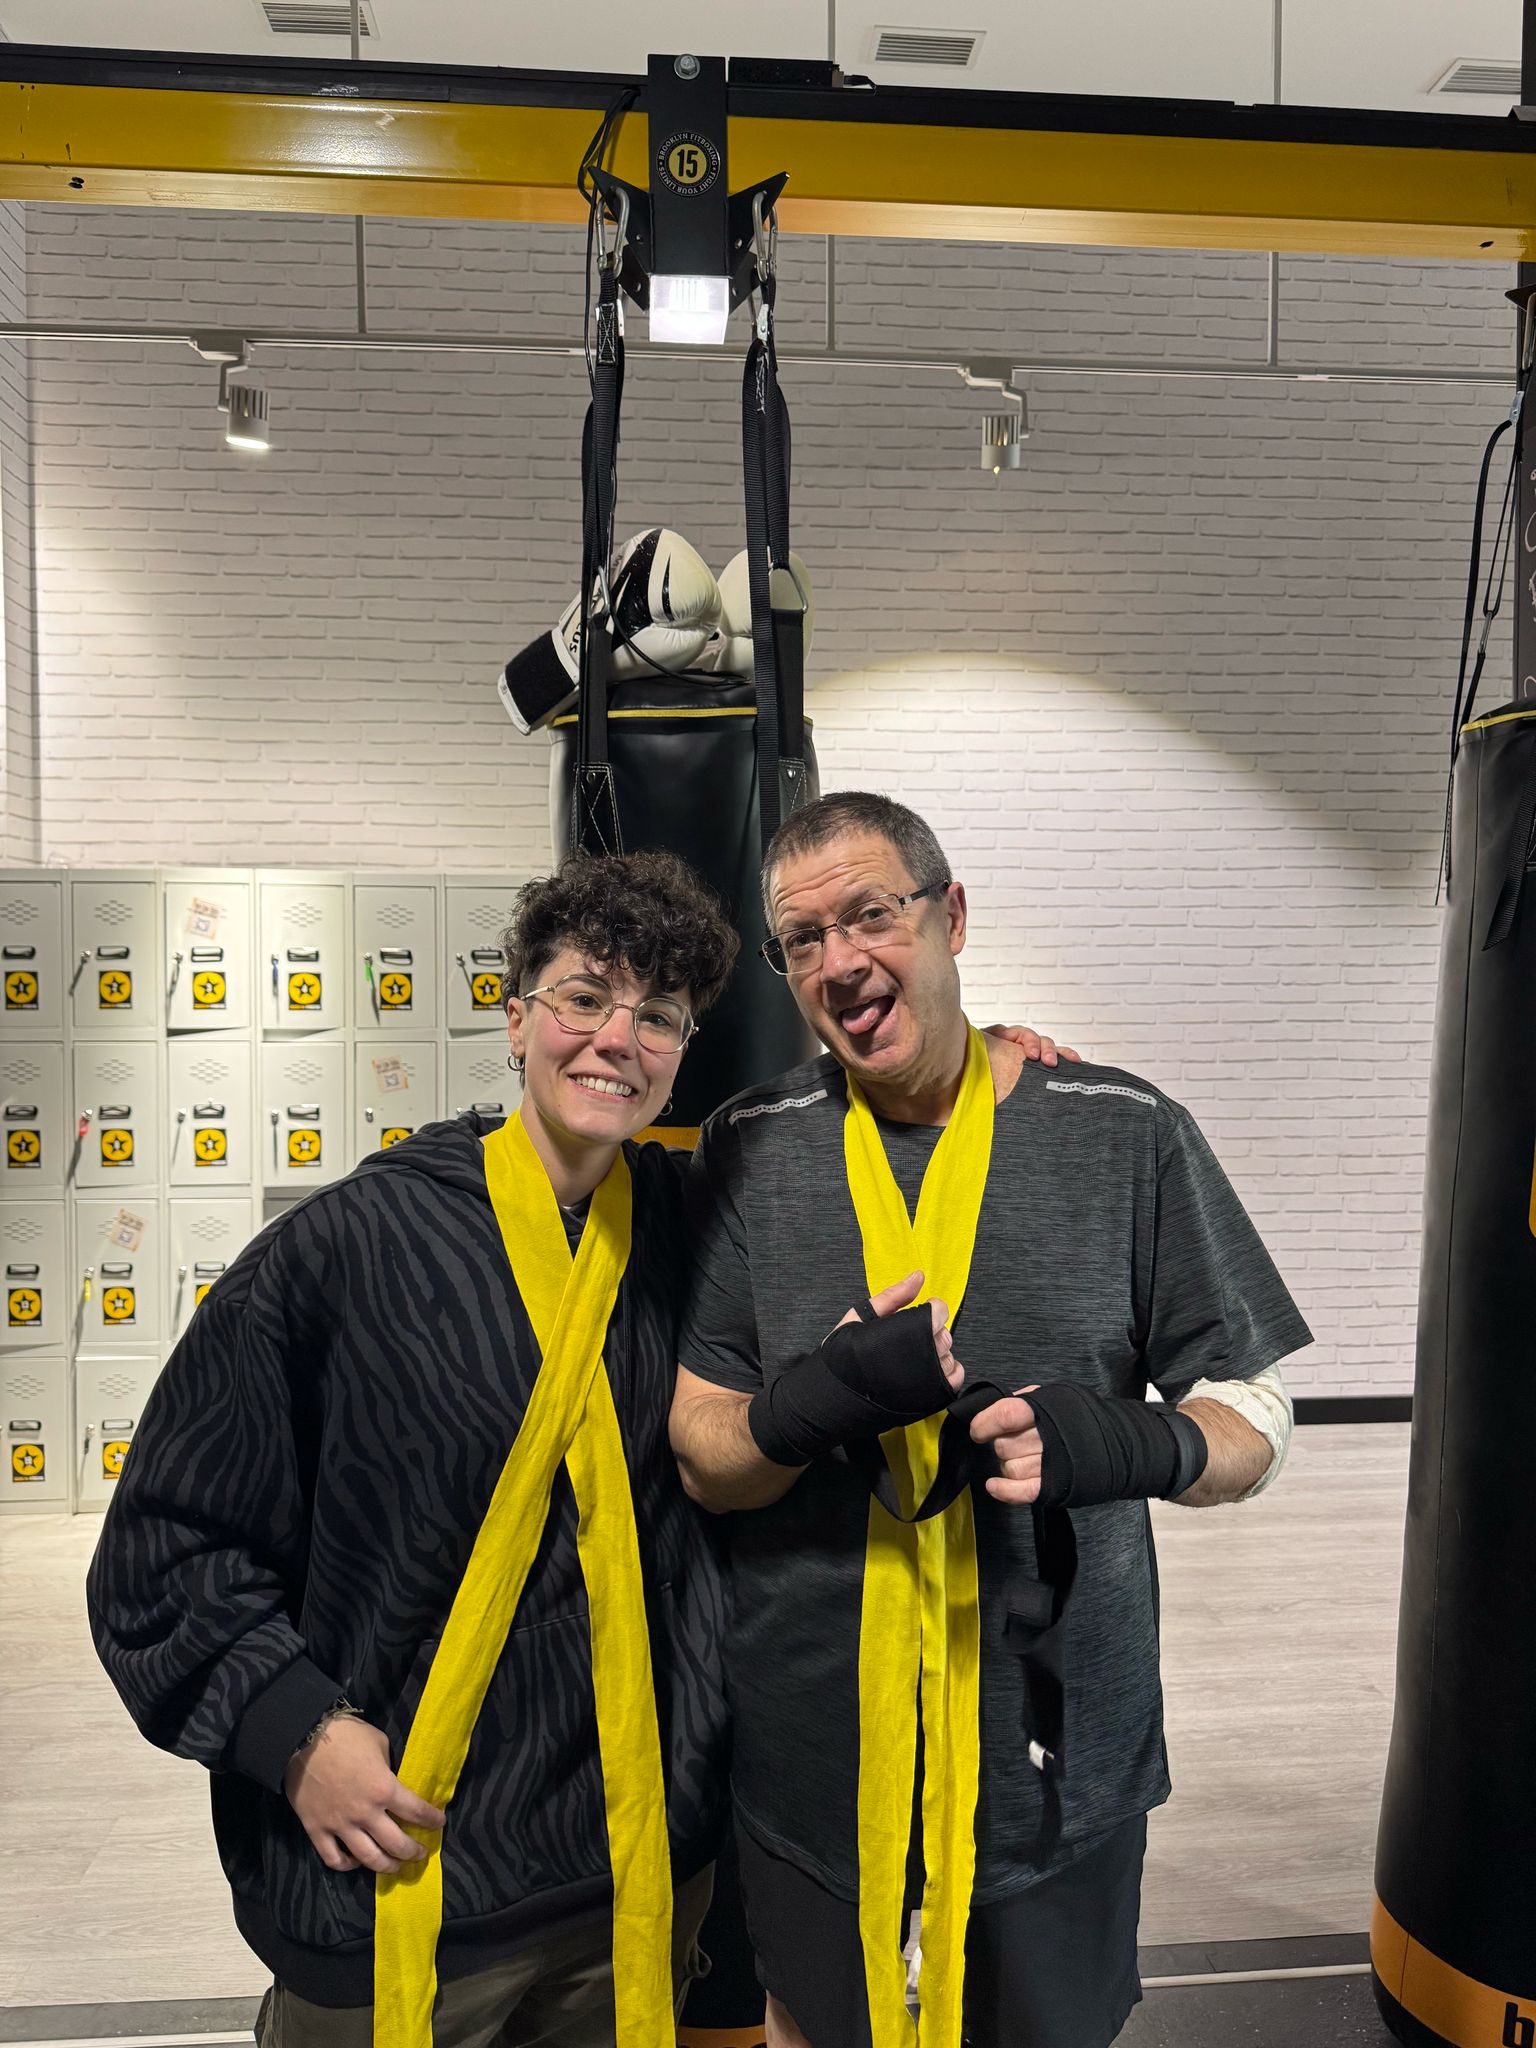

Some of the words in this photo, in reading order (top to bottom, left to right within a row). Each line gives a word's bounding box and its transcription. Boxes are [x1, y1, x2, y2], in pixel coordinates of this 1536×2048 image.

[658, 133, 688, 160] BROOKLYN
[690, 133, 718, 166] FITBOXING
[677, 149, 699, 178] 15
[658, 166, 677, 191] LIMITS
[677, 187, 699, 195] YOUR
[700, 172, 717, 192] FIGHT
